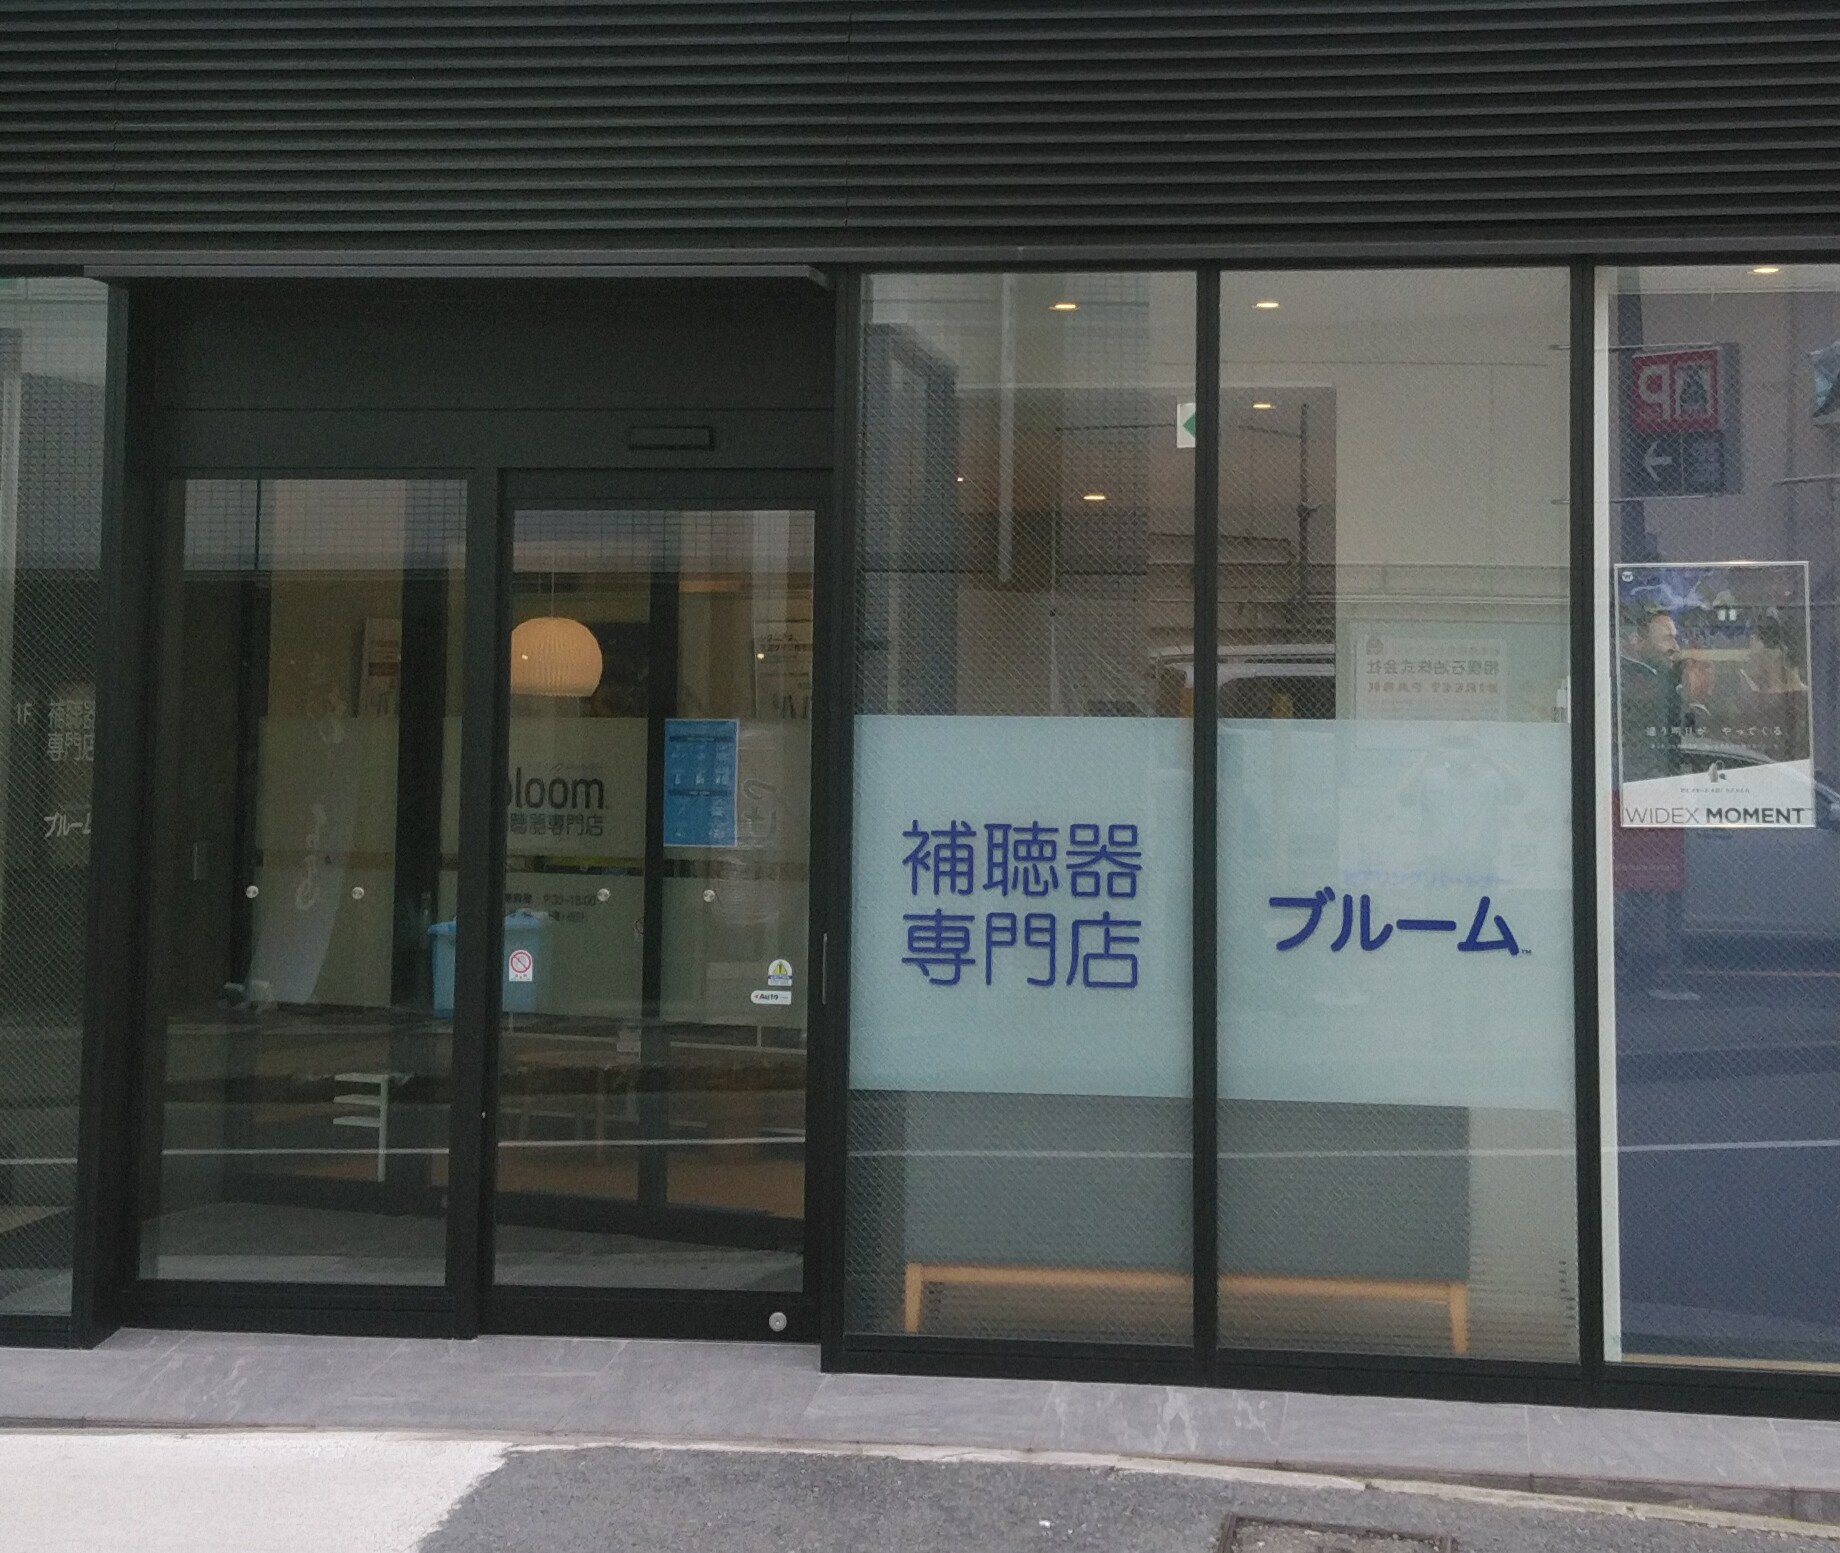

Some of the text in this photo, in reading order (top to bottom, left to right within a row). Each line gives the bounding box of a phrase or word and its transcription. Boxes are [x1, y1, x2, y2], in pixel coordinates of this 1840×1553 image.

[507, 767, 605, 810] loom
[1624, 806, 1803, 824] WIDEX MOMENT
[902, 820, 1143, 900] 補聴器
[901, 908, 1143, 989] 専門店
[1268, 886, 1519, 956] ブルーム
